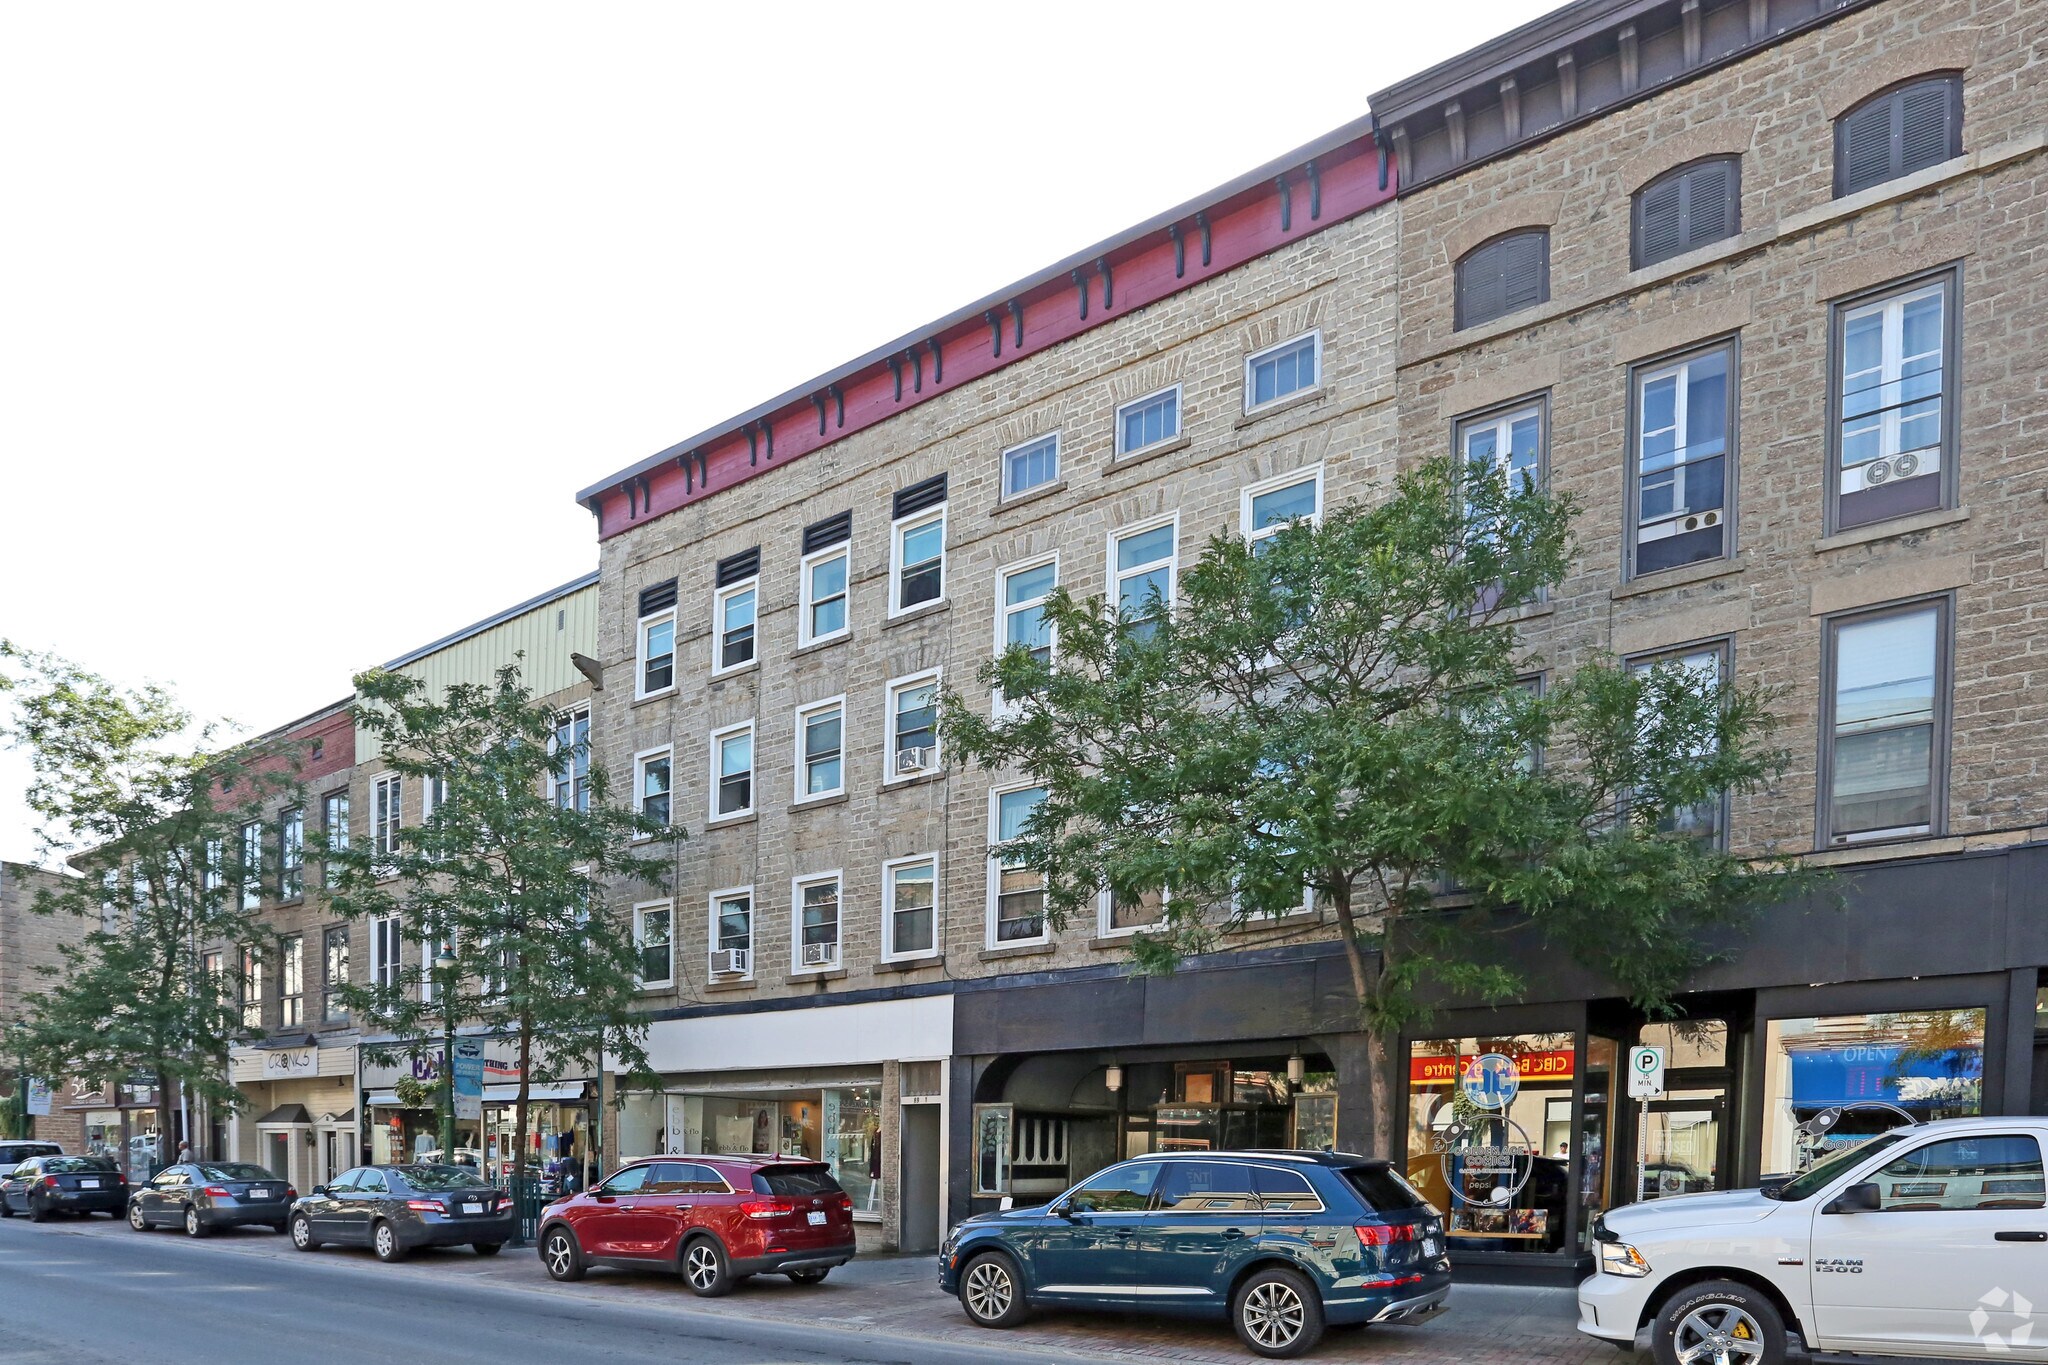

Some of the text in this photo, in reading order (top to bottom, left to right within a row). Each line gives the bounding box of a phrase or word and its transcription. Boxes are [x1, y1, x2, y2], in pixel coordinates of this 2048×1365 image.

[1843, 1046, 1888, 1062] OPEN
[1641, 1055, 1653, 1069] P
[1637, 1079, 1652, 1087] MIN
[718, 1143, 732, 1151] ebb
[739, 1143, 750, 1152] flo
[1465, 1155, 1512, 1167] COMICS
[1468, 1182, 1492, 1190] pepsi
[1815, 1258, 1864, 1267] RAM
[1815, 1265, 1864, 1274] 1500
[1669, 1292, 1747, 1323] WRANGLER
